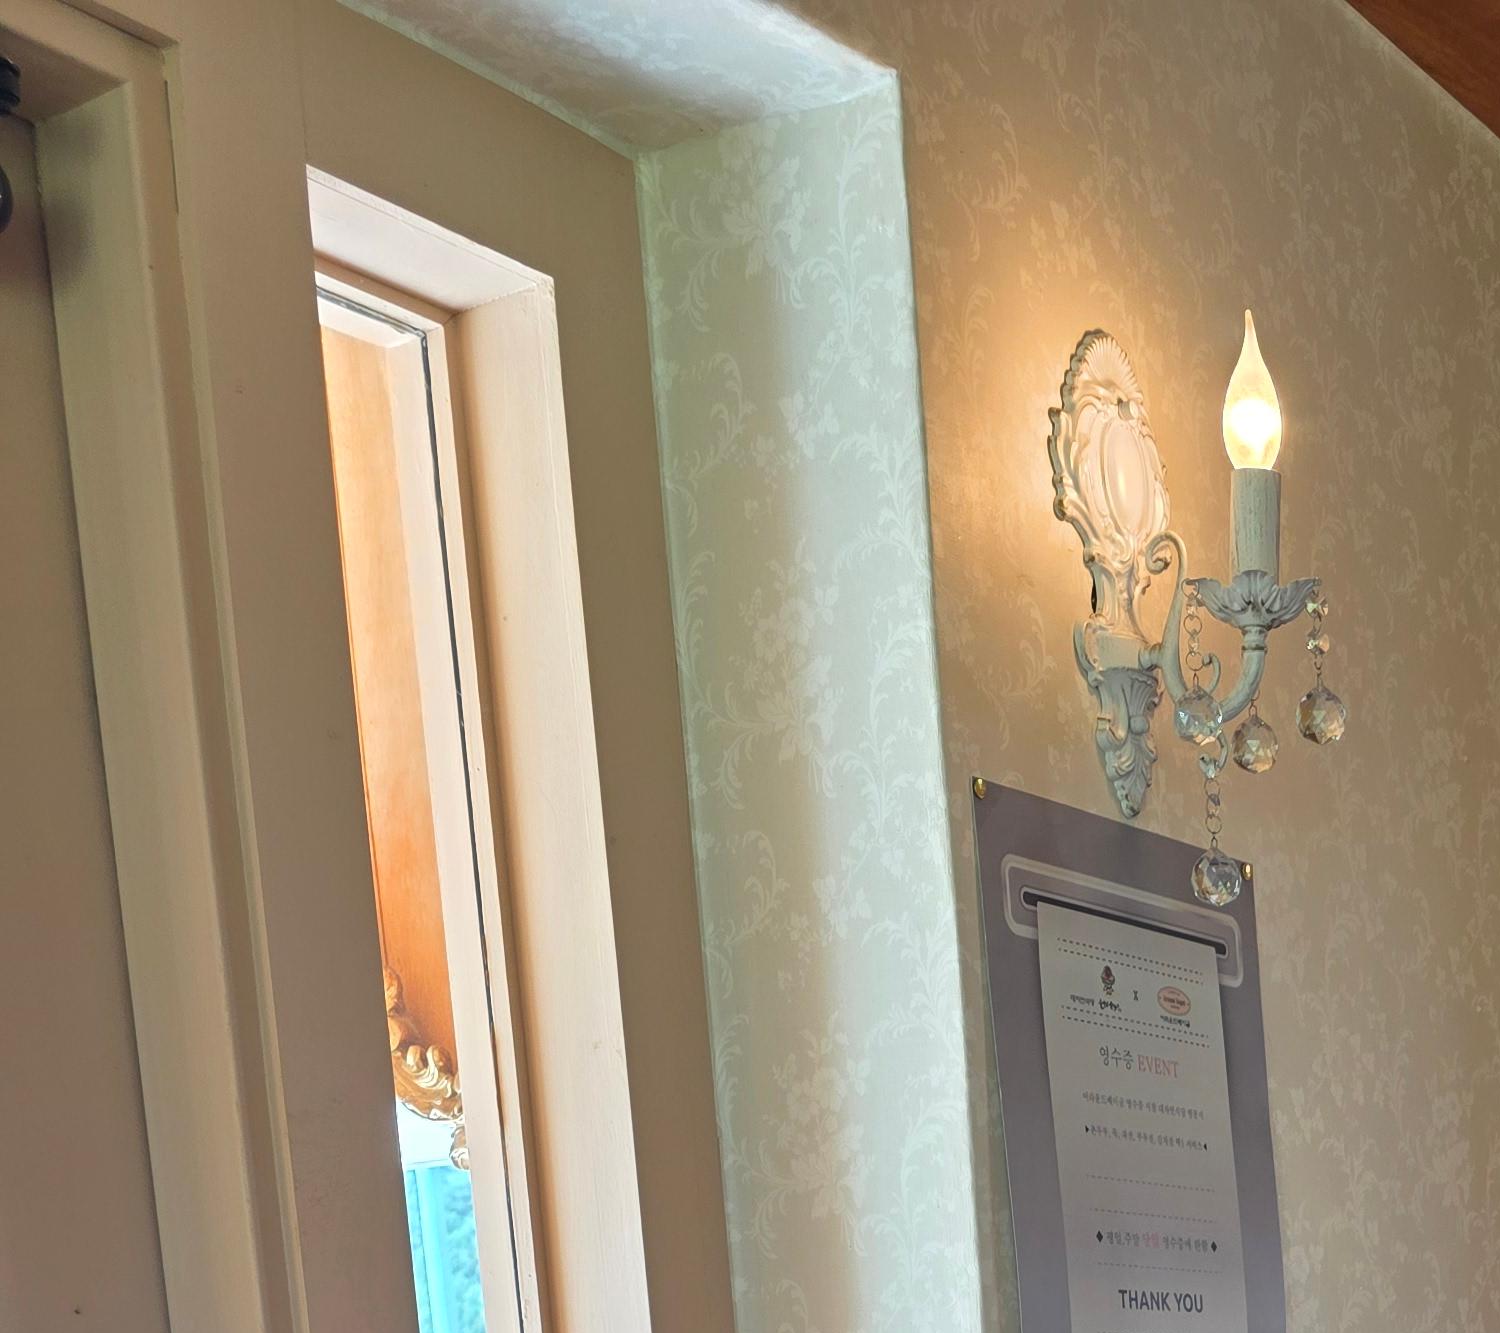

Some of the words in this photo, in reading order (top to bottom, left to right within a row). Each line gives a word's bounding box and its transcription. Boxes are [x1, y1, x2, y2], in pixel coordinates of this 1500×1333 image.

[1099, 1046, 1134, 1071] 영수증
[1137, 1054, 1180, 1079] EVENT
[1118, 1289, 1171, 1312] THANK
[1173, 1292, 1204, 1313] YOU
